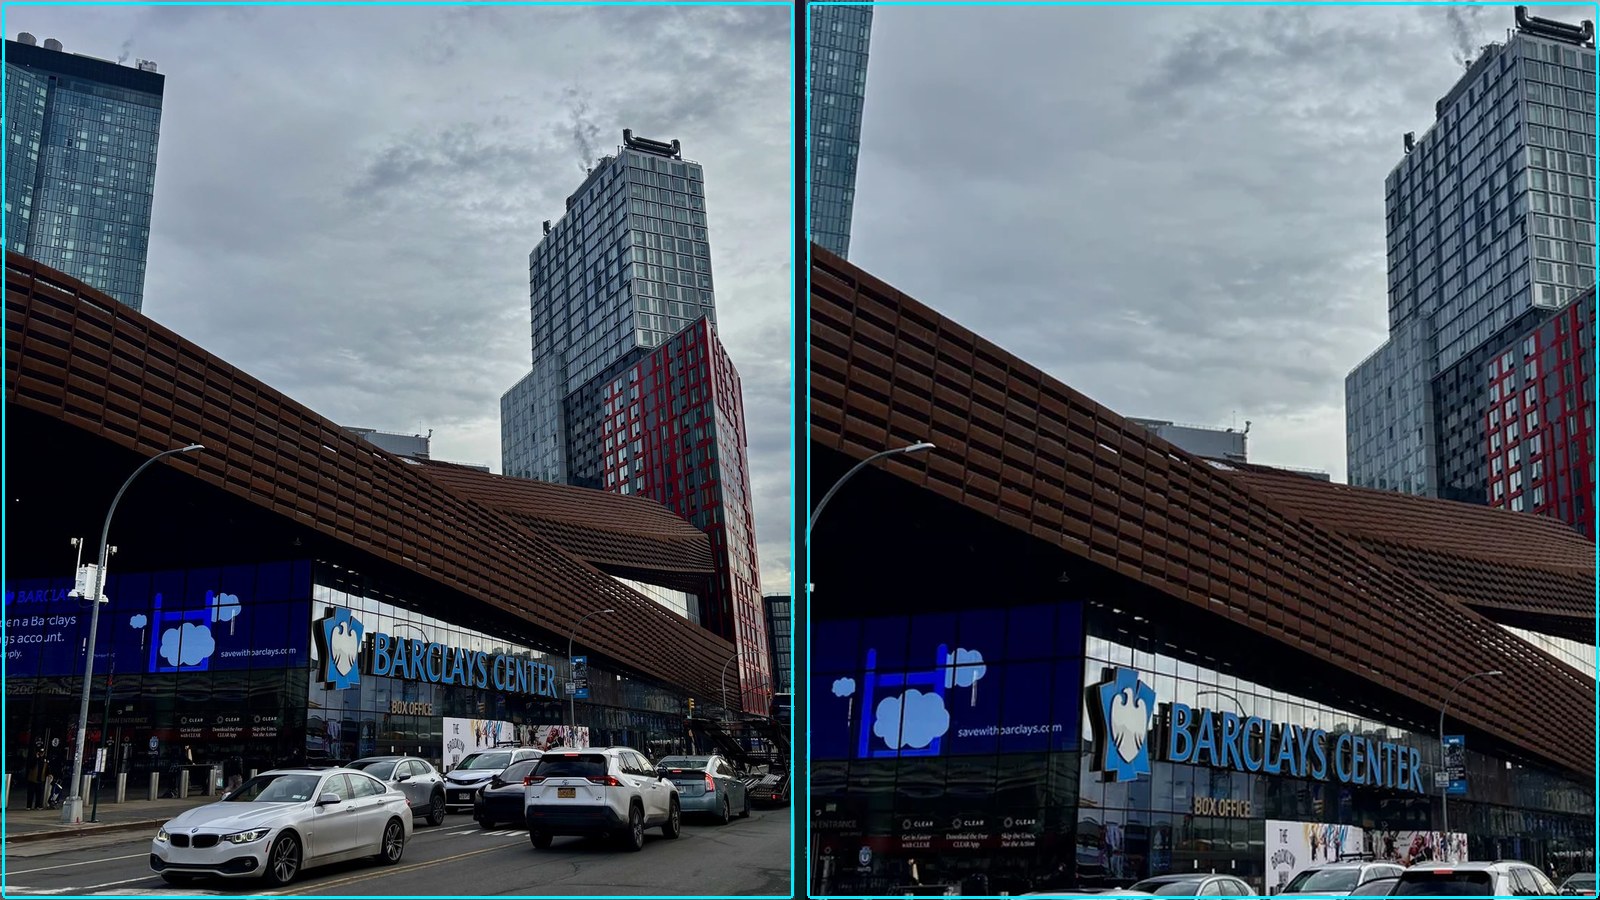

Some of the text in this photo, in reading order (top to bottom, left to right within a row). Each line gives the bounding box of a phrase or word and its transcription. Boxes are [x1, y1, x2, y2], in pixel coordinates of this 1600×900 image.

[16, 589, 71, 604] BARCLA
[21, 619, 29, 627] a
[373, 632, 558, 699] BARCLAYS CENTER
[391, 700, 433, 716] BOX OFFICE
[1169, 703, 1425, 794] BARCLAYS CENTER
[1194, 796, 1251, 818] BOX OFFICE
[1014, 818, 1036, 826] CLEAR
